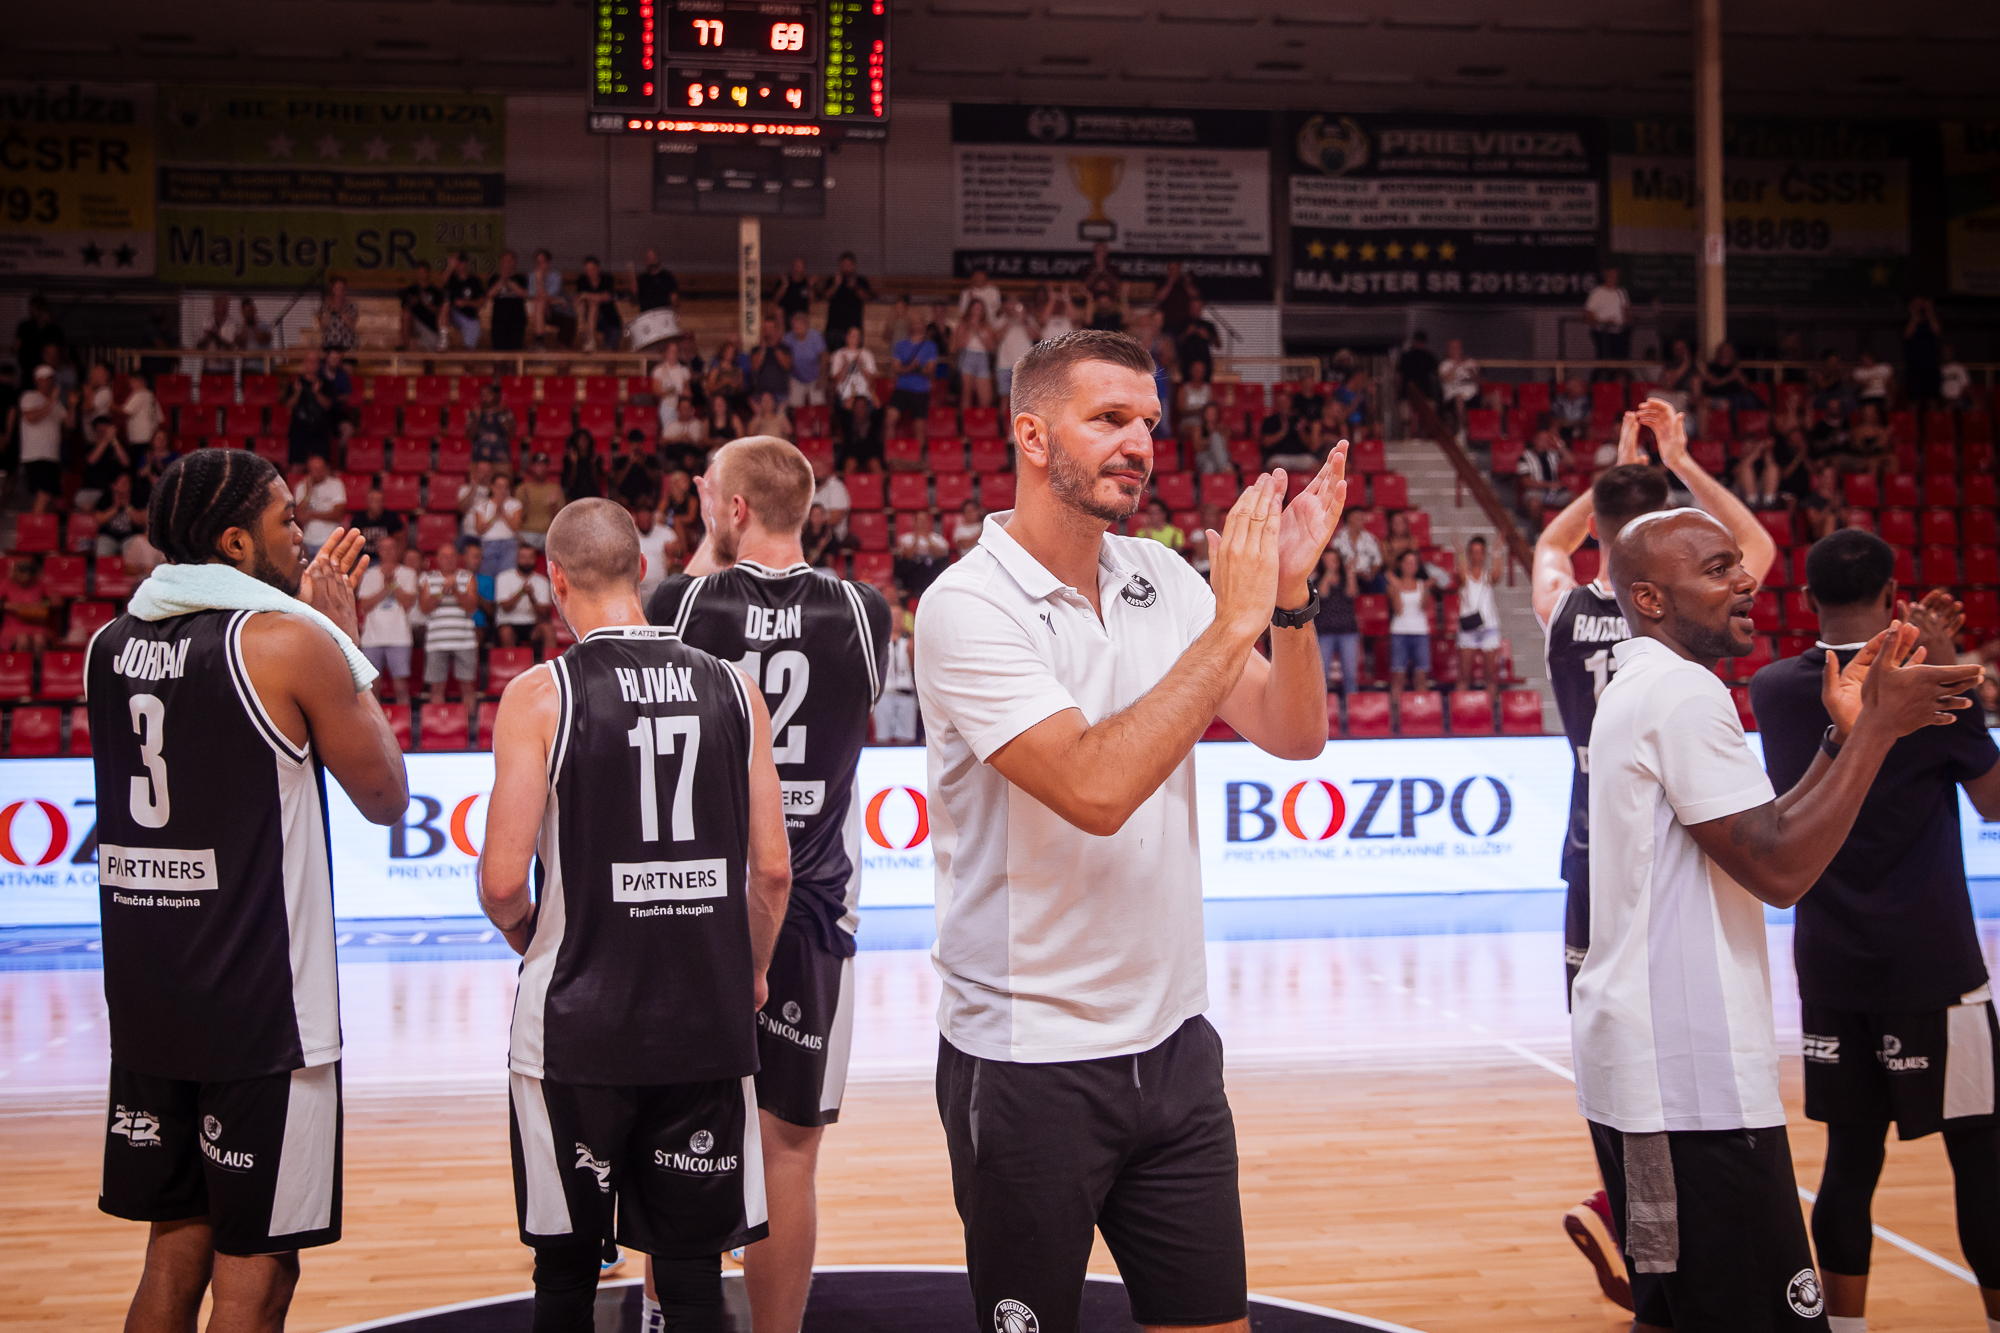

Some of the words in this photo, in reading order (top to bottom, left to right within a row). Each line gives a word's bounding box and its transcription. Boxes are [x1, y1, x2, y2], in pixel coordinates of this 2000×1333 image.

[693, 19, 724, 46] 77
[770, 22, 805, 51] 69
[1378, 129, 1586, 156] PRIEVIDZA
[1778, 165, 1886, 204] ČSSR
[168, 226, 339, 277] Majster
[355, 228, 419, 270] SR
[1294, 269, 1420, 294] MAJSTER
[1425, 270, 1462, 294] SR
[1469, 270, 1598, 294] 2015/2016
[745, 604, 802, 642] DEAN
[113, 637, 192, 681] JORDAN
[615, 662, 698, 704] HLIVÁK
[129, 693, 170, 829] 3
[627, 715, 701, 842] 17
[1226, 775, 1513, 843] BOZPO
[108, 855, 206, 880] PARTNERS
[622, 869, 718, 892] PARTNERS
[113, 892, 154, 908] Finančná
[156, 895, 201, 909] skupina
[629, 904, 674, 918] Finančná
[675, 903, 714, 917] skupina
